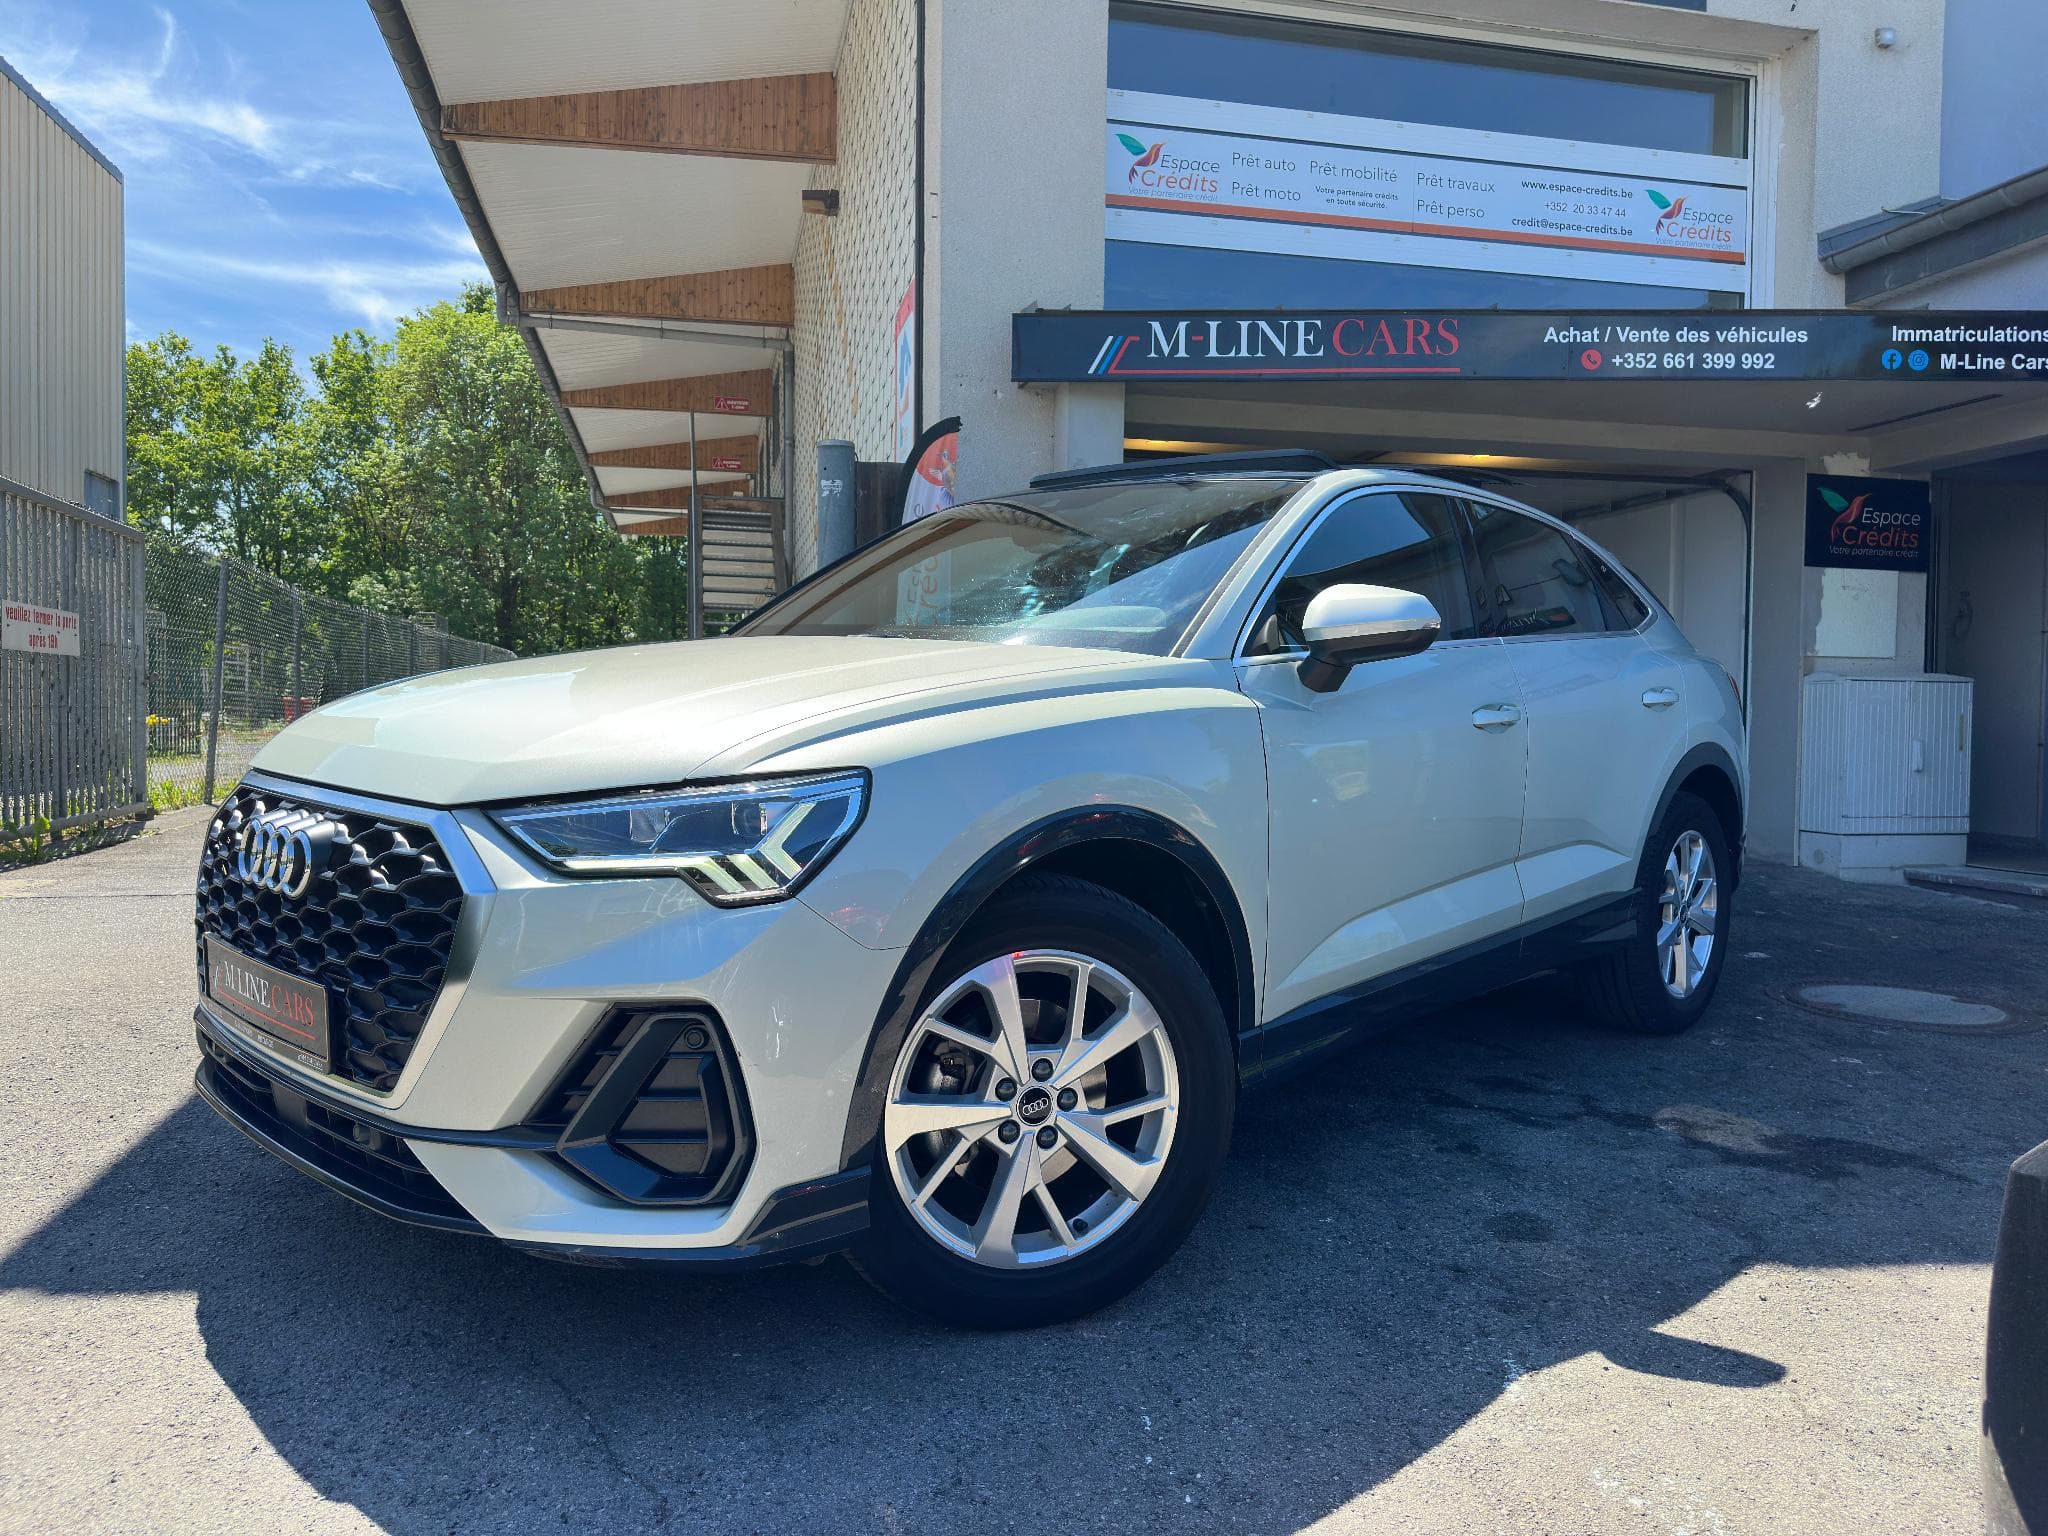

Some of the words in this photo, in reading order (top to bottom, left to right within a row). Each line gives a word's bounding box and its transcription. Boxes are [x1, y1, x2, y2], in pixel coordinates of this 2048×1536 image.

[1160, 154, 1220, 173] Espace
[1232, 152, 1260, 168] Prêt
[1264, 159, 1296, 172] auto
[1310, 160, 1337, 178] Prêt
[1341, 164, 1398, 183] mobilité
[1141, 169, 1218, 193] Crédits
[1232, 181, 1260, 198] Prêt
[1264, 188, 1301, 201] moto
[1417, 172, 1444, 188] Prêt
[1447, 177, 1495, 194] travaux
[1521, 180, 1633, 199] www.espace-credits.be
[1315, 186, 1335, 194] Votre
[1337, 188, 1373, 198] partenaire
[1374, 192, 1399, 201] crédits
[1417, 200, 1444, 215] Prêt
[1447, 205, 1485, 220] perso
[1544, 201, 1568, 212] +352
[1573, 204, 1584, 214] 20
[1587, 205, 1599, 215] 33
[1601, 206, 1613, 217] 47
[1614, 208, 1626, 218] 44
[1683, 207, 1734, 224] Espace
[1511, 217, 1633, 236] credit@espace-credits.be
[1666, 221, 1732, 243] Crédits
[1146, 319, 1325, 359] M-LINE
[1331, 317, 1460, 357] CARS
[1543, 326, 1600, 343] Achat
[1604, 326, 1612, 343] /
[1616, 326, 1670, 343] Vente
[1675, 326, 1710, 343] des
[1715, 326, 1809, 343] véhicules
[1611, 352, 1657, 369] +352
[1663, 352, 1694, 369] 661
[1702, 352, 1736, 369] 399
[1741, 352, 1775, 369] 992
[1940, 353, 2006, 370] M-Line
[1861, 507, 1921, 528] Espace
[1842, 525, 1919, 548] Crédits
[1829, 545, 1850, 555] Votre
[5, 605, 31, 623] veuillez
[55, 613, 61, 628] la
[270, 984, 315, 1028] CARS
